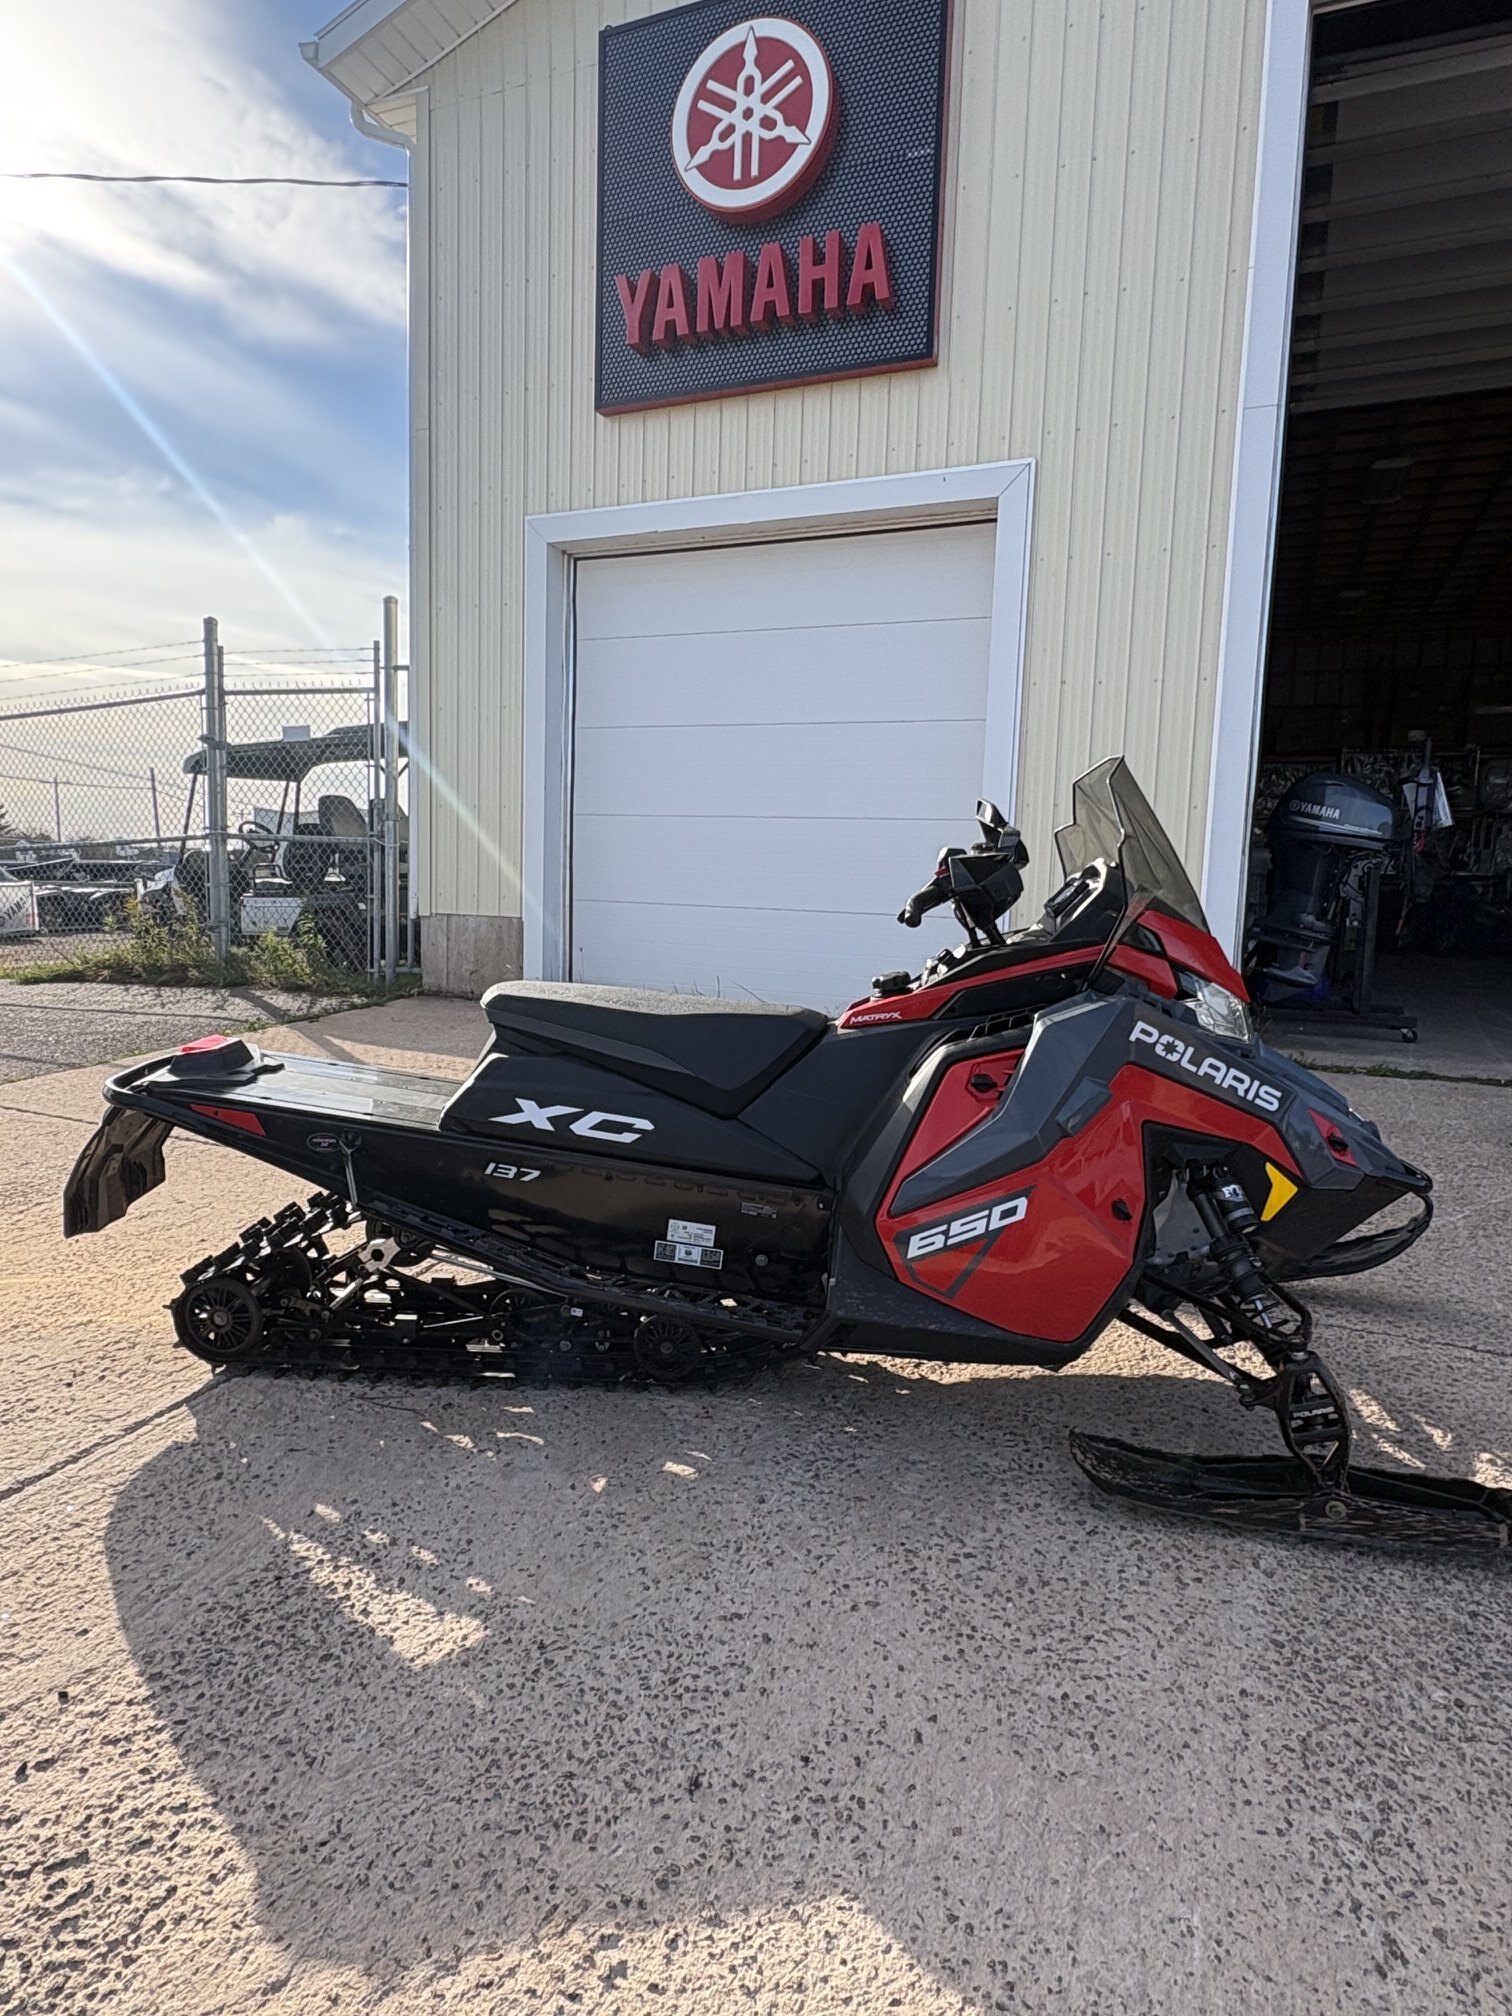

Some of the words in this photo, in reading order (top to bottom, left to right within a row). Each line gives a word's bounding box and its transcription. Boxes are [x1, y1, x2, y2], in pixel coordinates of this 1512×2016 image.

[614, 221, 891, 348] YAMAHA
[1301, 801, 1340, 820] YAMAHA
[3, 890, 31, 920] YAMAH
[849, 1011, 902, 1025] MATRYX
[1128, 1020, 1282, 1113] POLARIS
[489, 1097, 655, 1143] XC
[484, 1162, 542, 1182] 137
[906, 1196, 1028, 1260] 650
[1293, 1406, 1335, 1418] POLARIS
